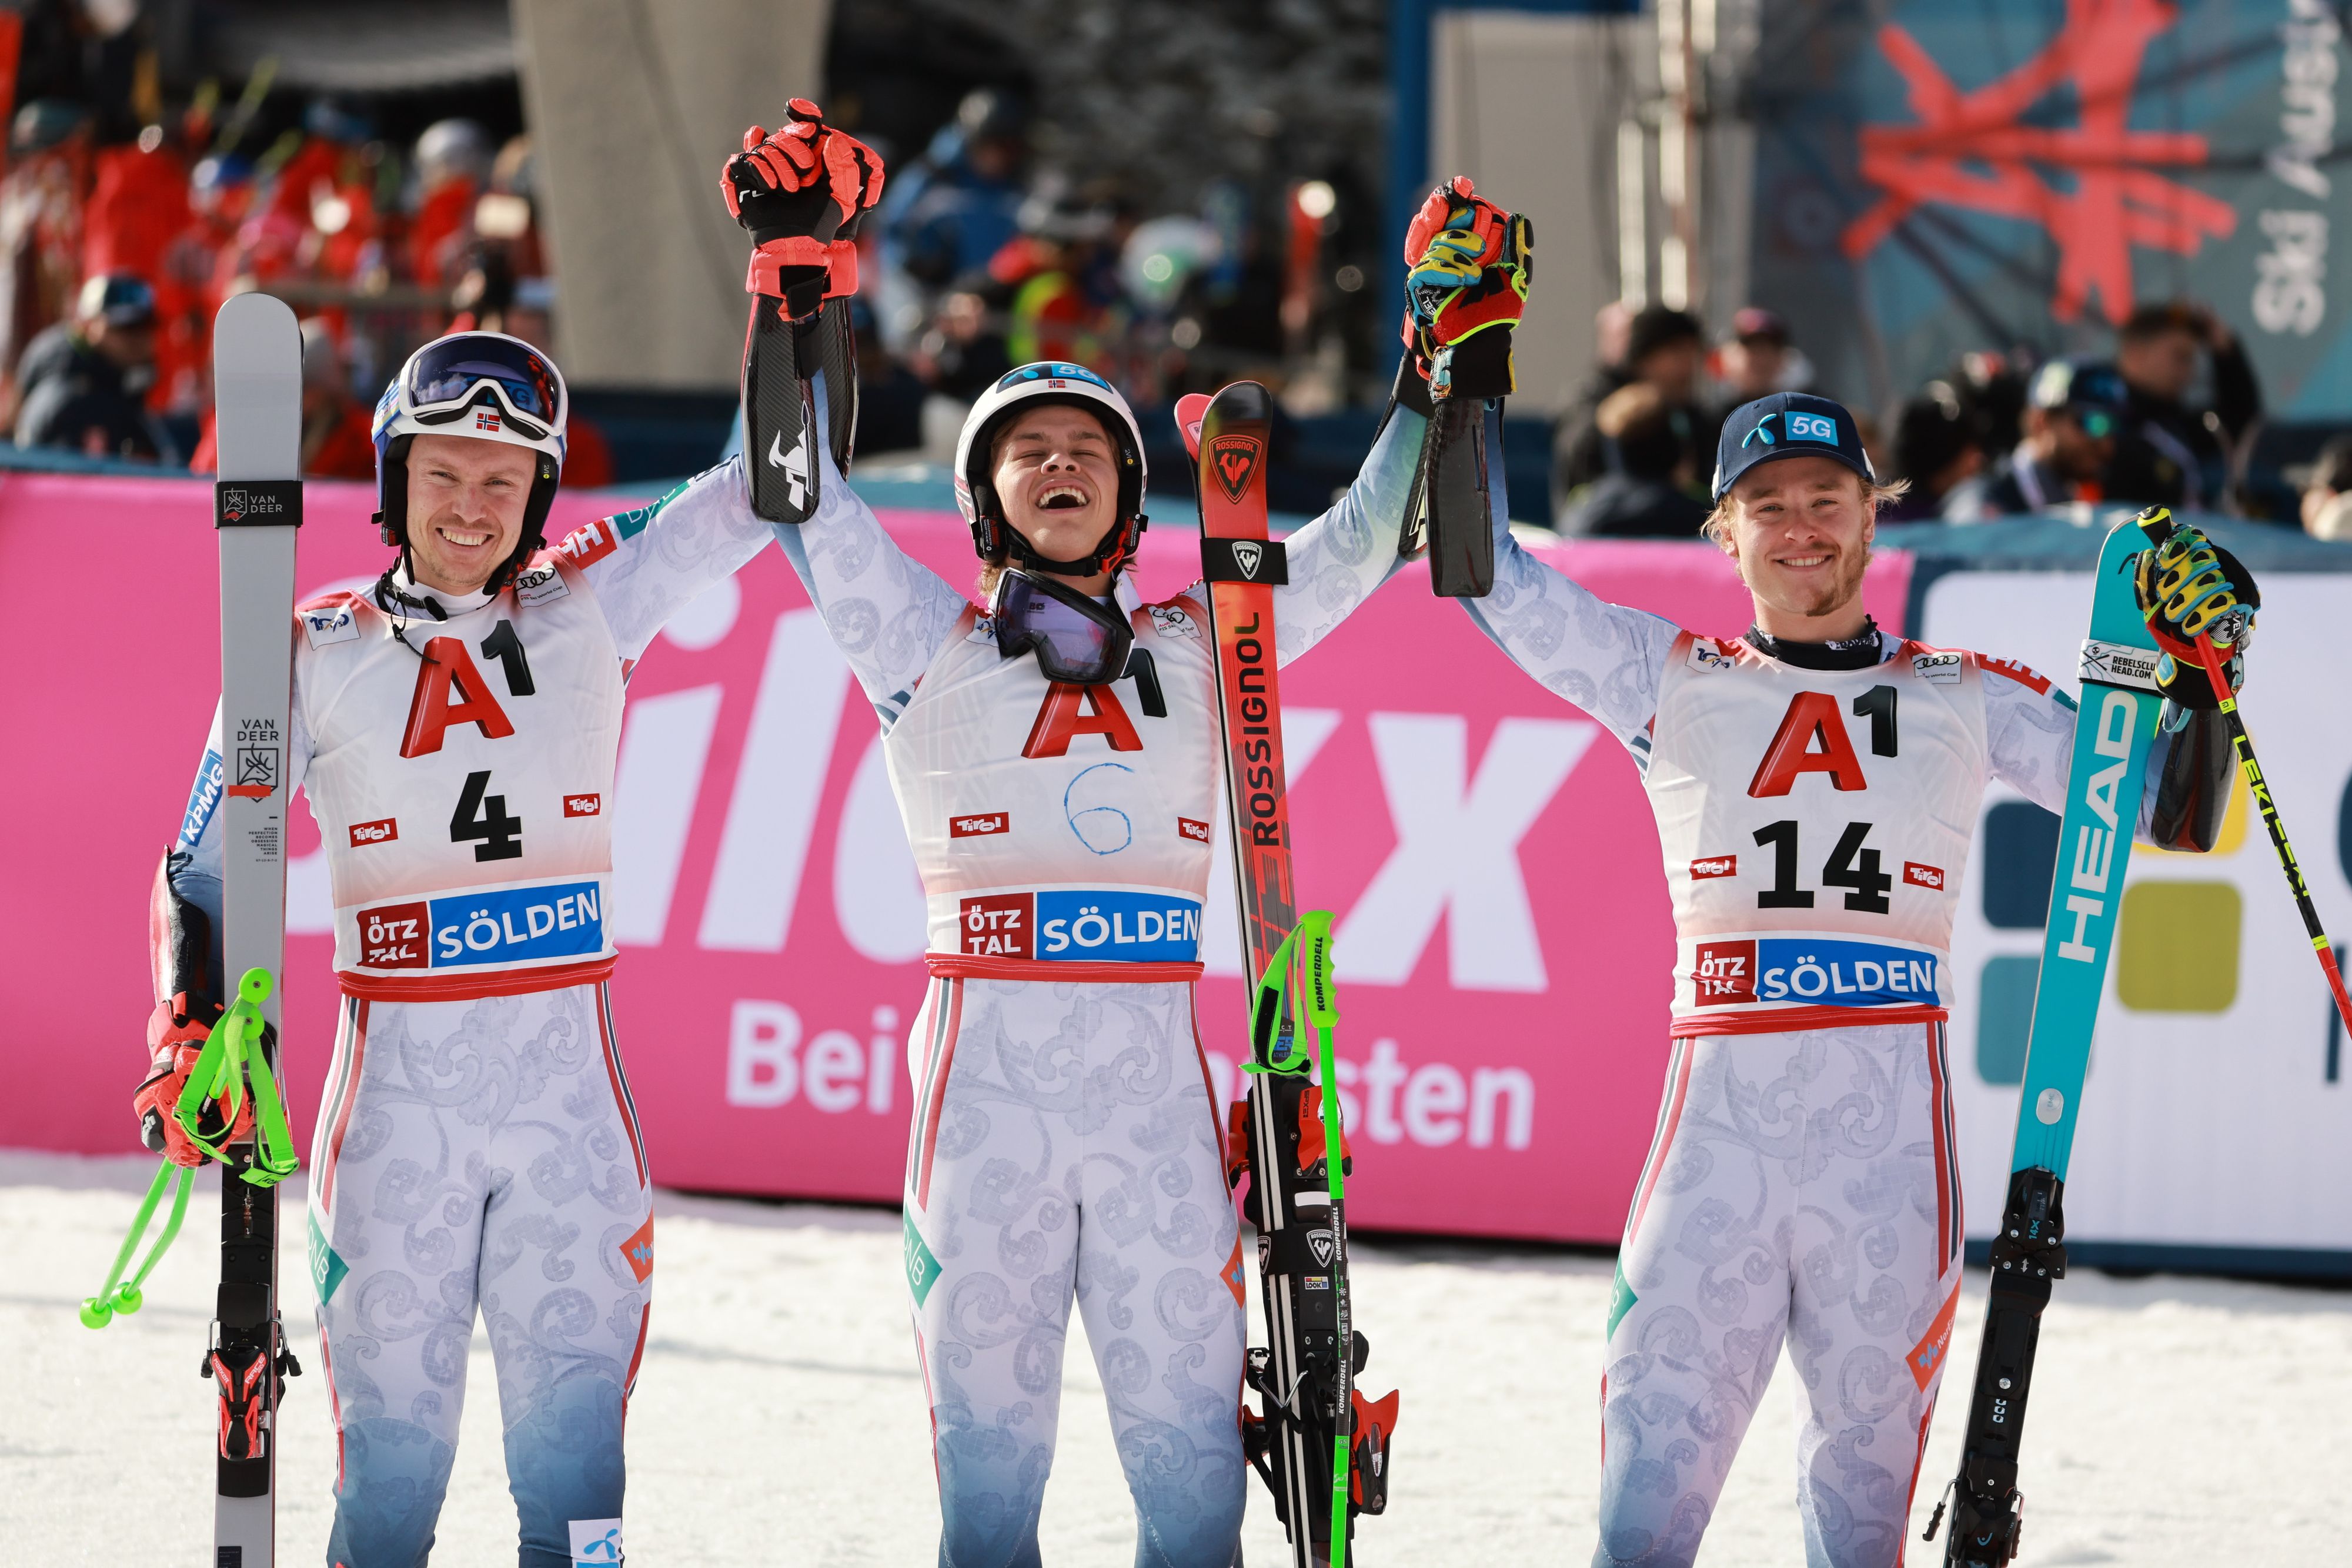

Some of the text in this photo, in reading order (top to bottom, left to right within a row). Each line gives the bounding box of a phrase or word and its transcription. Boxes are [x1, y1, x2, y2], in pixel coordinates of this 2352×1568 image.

[2252, 209, 2327, 336] Ski
[1058, 366, 1099, 382] 5G
[1792, 416, 1831, 438] 5G
[1215, 441, 1255, 453] ROSSIGNOL
[250, 495, 275, 504] VAN
[250, 504, 283, 513] DEER
[1236, 543, 1258, 553] ROSSIGNOL
[537, 590, 552, 599] World
[2111, 664, 2151, 680] HEAD.COM
[2112, 656, 2156, 671] REBELSCLU
[399, 619, 536, 758] A1
[1021, 647, 1168, 759] A1
[237, 731, 279, 741] DEER
[242, 719, 274, 730] VAN
[1234, 612, 1280, 848] ROSSIGNOL
[1746, 684, 1898, 798] A1
[2233, 735, 2274, 818] LEKI
[185, 763, 223, 842] KPMG
[569, 797, 599, 814] Tirol
[1064, 762, 1136, 856] 6
[449, 770, 523, 862] 4
[957, 816, 1001, 833] Tirol
[2057, 690, 2137, 964] HEAD
[353, 823, 390, 841] Tirol
[1182, 823, 1208, 840] Tirol
[1693, 859, 1730, 875] Tirol
[1752, 820, 1892, 915] 14
[1910, 867, 1941, 886] Tirol
[368, 915, 419, 944] ÖTZ
[437, 888, 599, 958] SÖLDEN
[968, 905, 1021, 931] ÖTZ
[1043, 906, 1199, 952] SÖLDEN
[968, 934, 1021, 955] TAL
[1314, 937, 1325, 1011] KOMPERDELL
[1700, 951, 1745, 977] ÖTZ
[1764, 955, 1933, 998] SÖLDEN
[726, 1001, 896, 1114] Bei
[1332, 1206, 1342, 1261] KOMPERDELL
[2029, 1219, 2040, 1241] 14X
[308, 1224, 329, 1284] DNB
[213, 1358, 229, 1383] MARKER
[245, 1355, 265, 1384] RACE
[1339, 1359, 1347, 1414] KOMPERDELL
